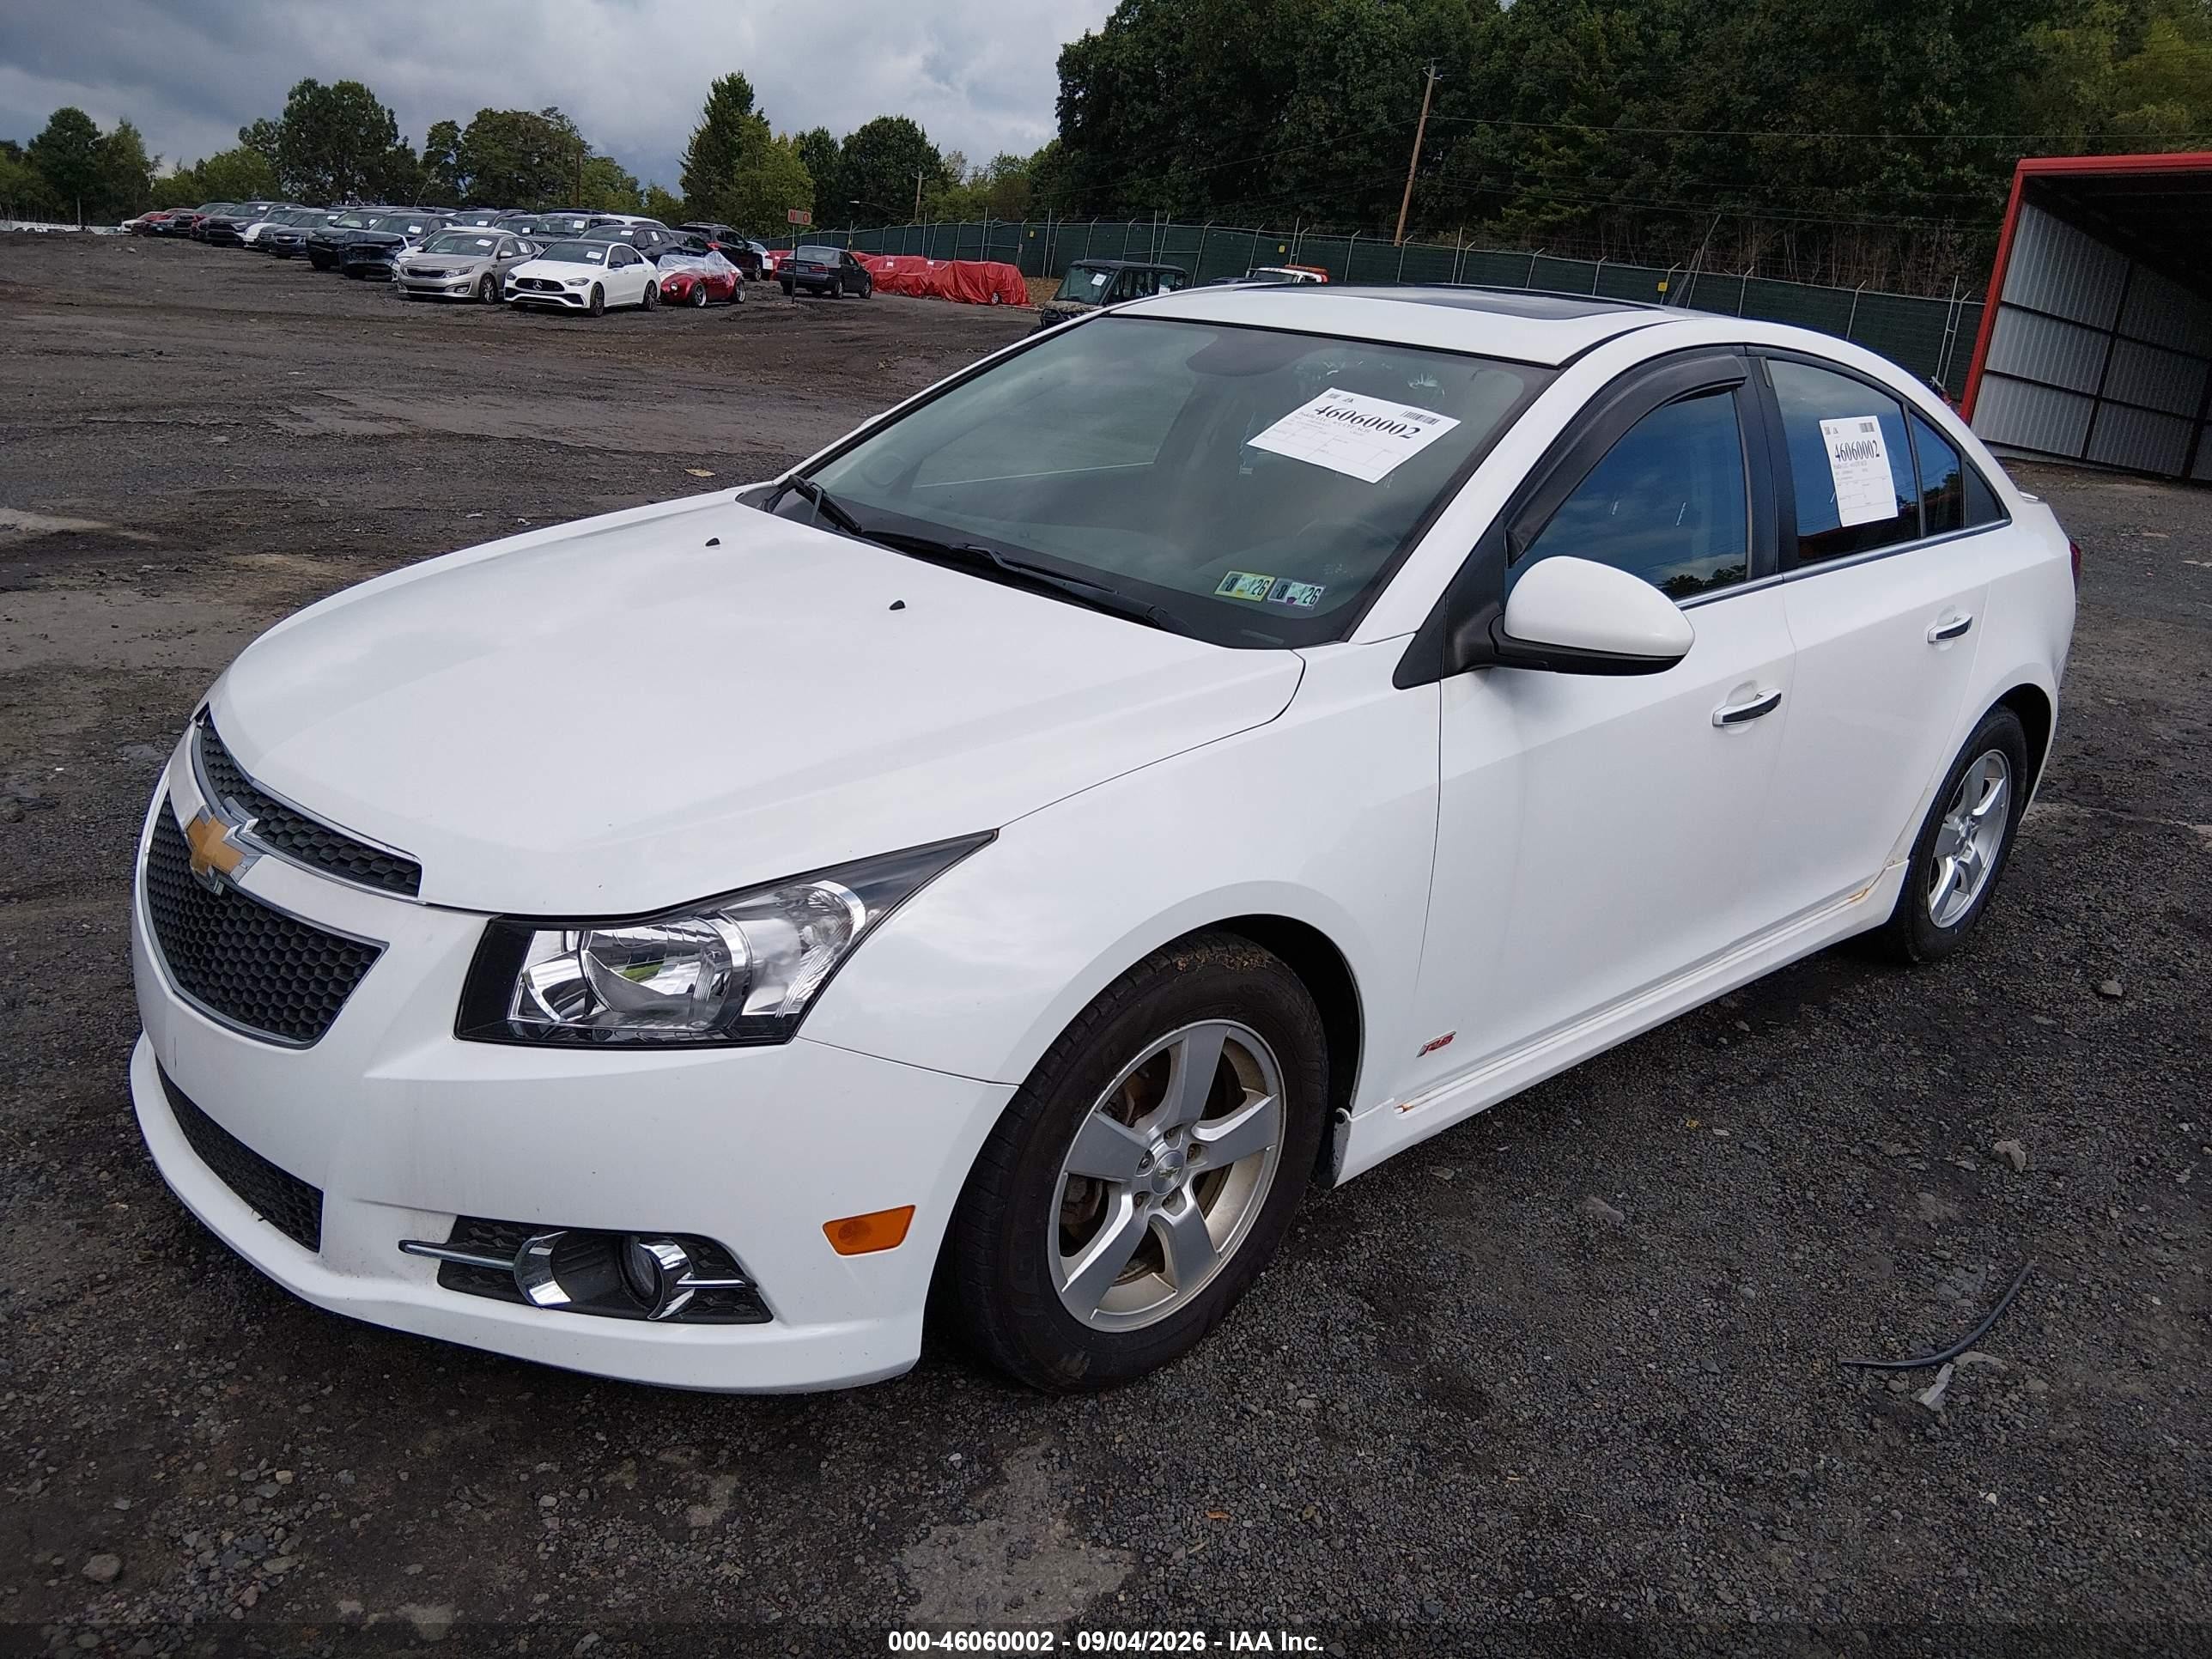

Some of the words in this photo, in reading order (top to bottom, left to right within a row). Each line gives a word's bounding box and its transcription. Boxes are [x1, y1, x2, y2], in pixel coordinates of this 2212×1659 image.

[1314, 404, 1422, 440] 46060002
[1834, 439, 1881, 463] 46060002
[1251, 579, 1270, 596] 26
[1302, 586, 1322, 605] 26
